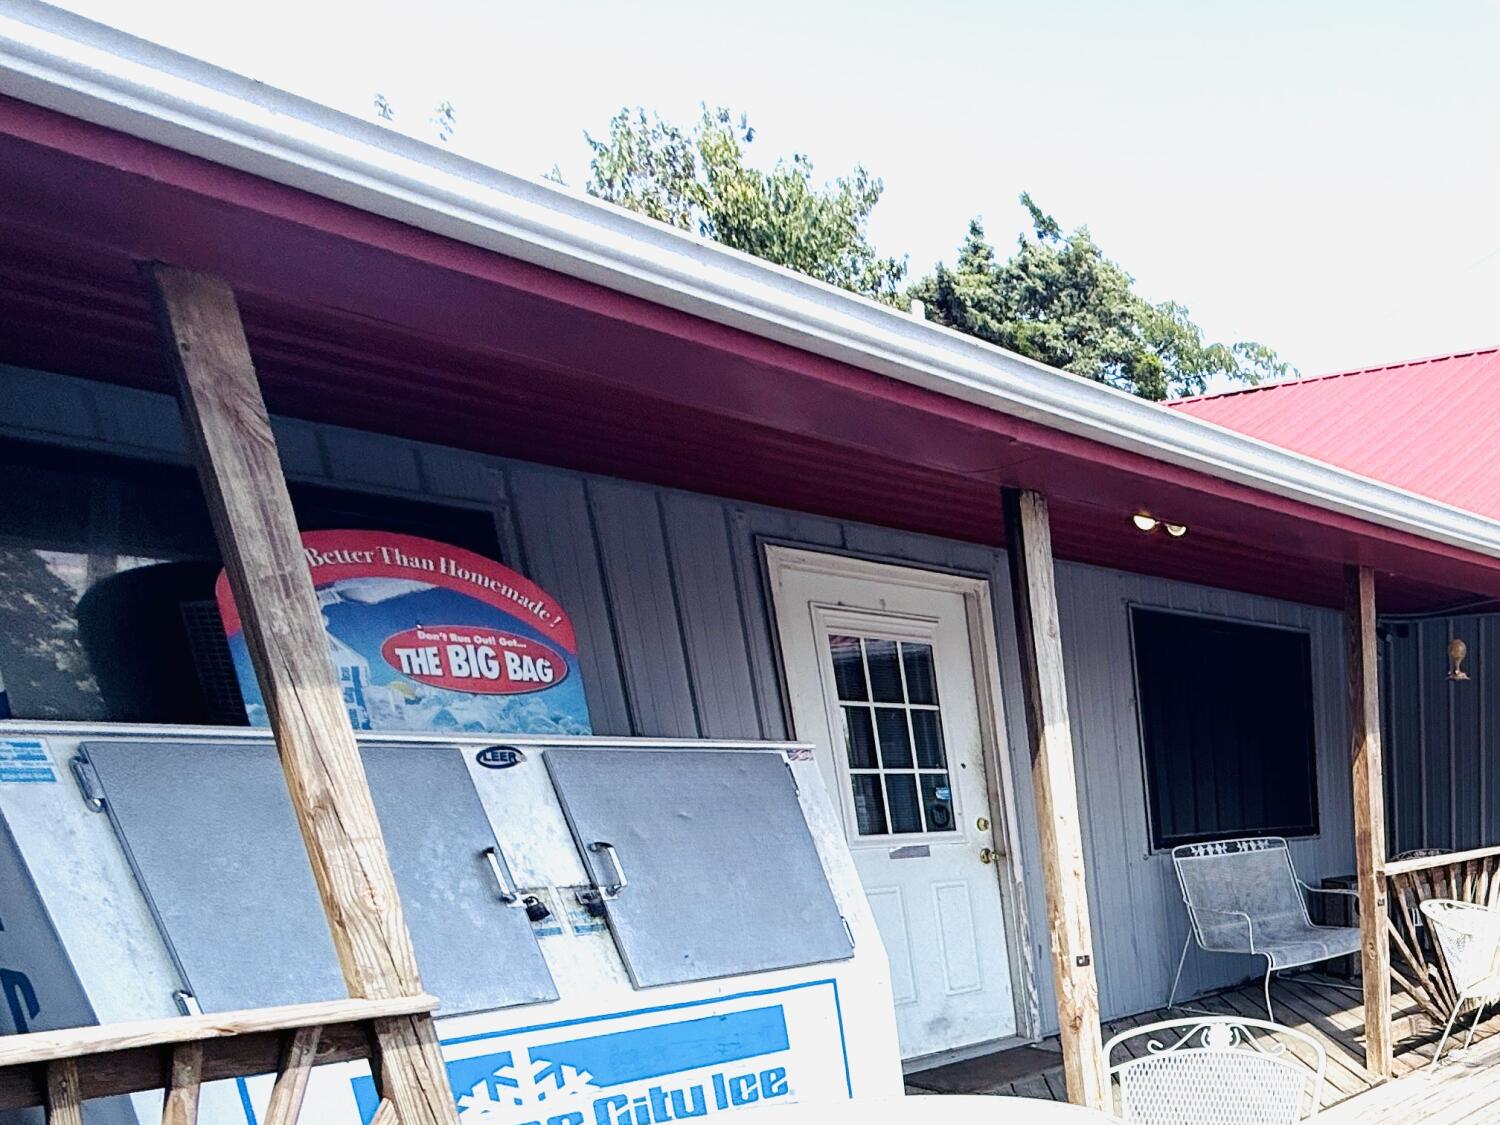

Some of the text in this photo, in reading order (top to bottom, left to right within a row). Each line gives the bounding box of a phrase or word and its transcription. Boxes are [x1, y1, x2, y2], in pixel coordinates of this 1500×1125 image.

[304, 547, 374, 568] Better
[377, 546, 435, 571] Than
[417, 630, 447, 642] Don't
[449, 633, 471, 643] Run
[395, 645, 554, 683] THE BIG BAG
[482, 751, 518, 763] LEER
[711, 1066, 789, 1111] Ice
